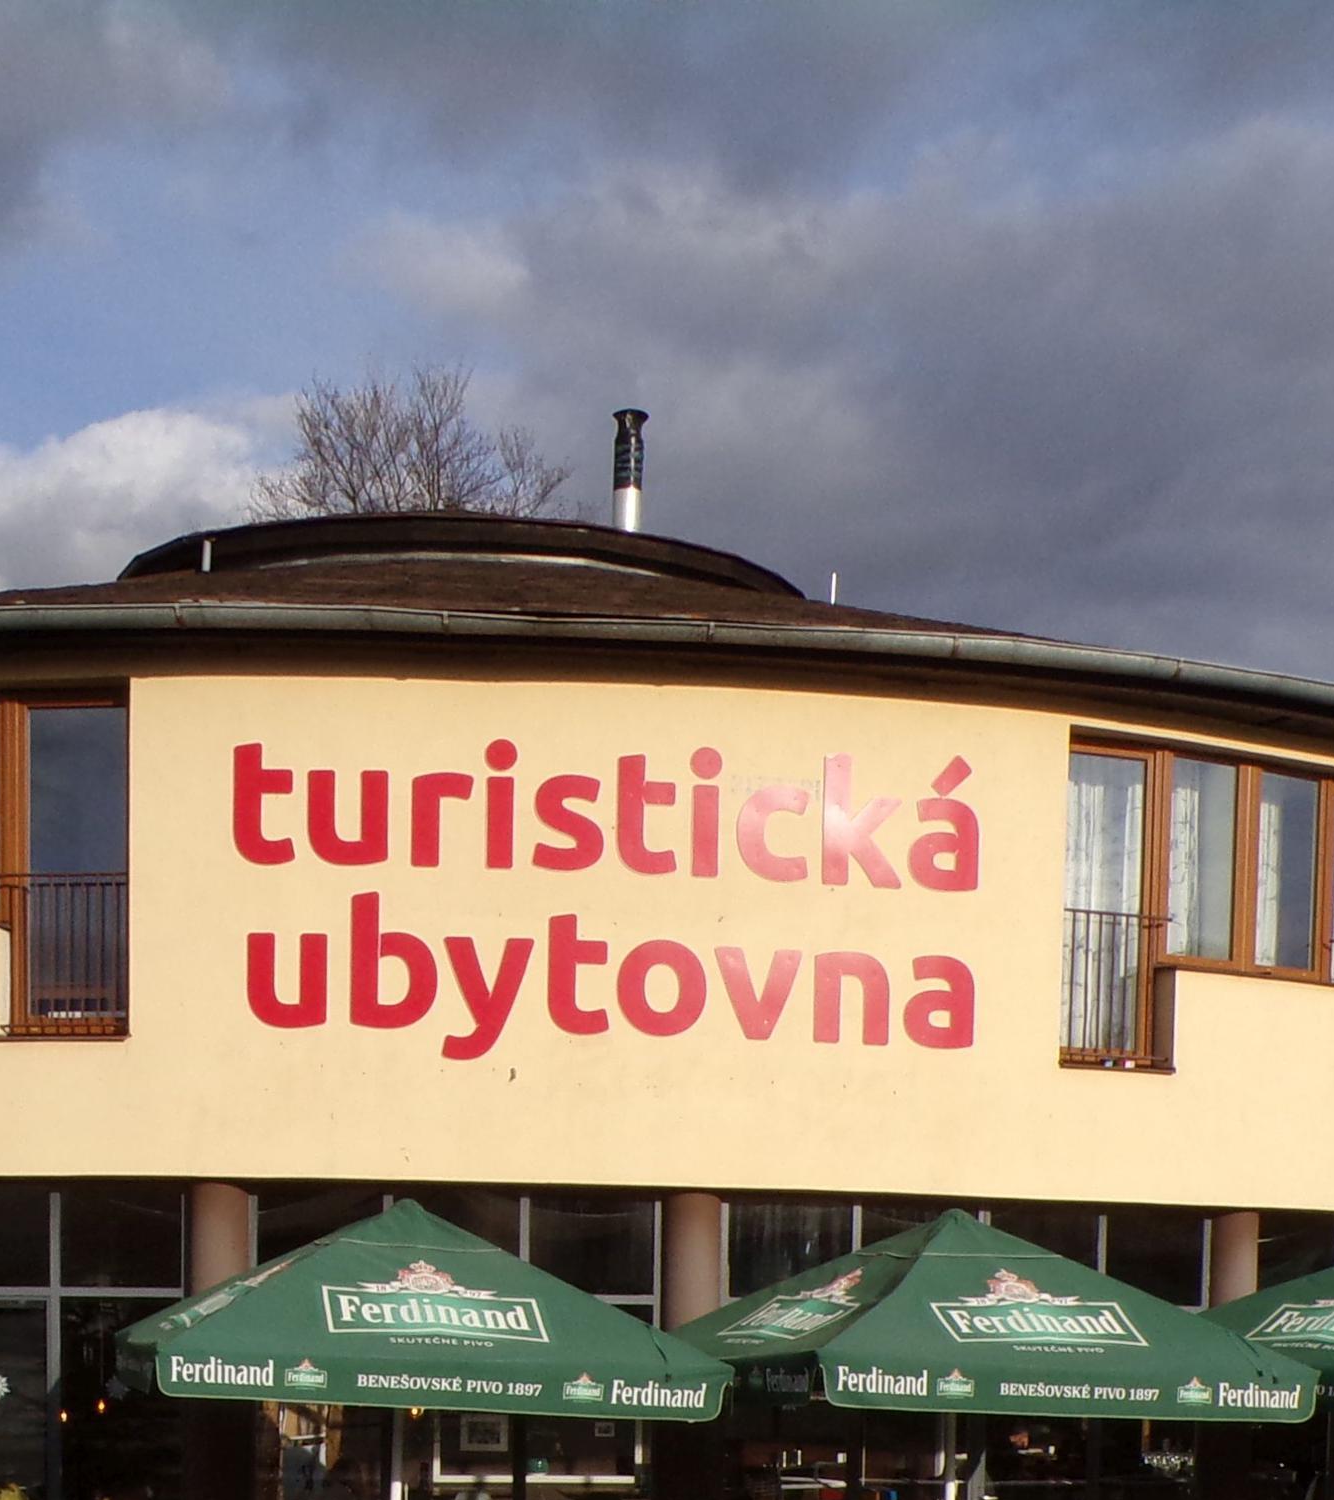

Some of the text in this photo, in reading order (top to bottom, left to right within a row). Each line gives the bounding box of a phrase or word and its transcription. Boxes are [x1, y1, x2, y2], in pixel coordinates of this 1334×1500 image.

[233, 738, 979, 892] turistická
[246, 891, 976, 1061] ubytovna
[336, 1294, 532, 1332] Ferdinand
[946, 1306, 1129, 1336] Ferdinand
[170, 1355, 275, 1387] Ferdinand
[356, 1372, 543, 1398] BENEŠOVSKÉ PIVO 1897
[836, 1364, 929, 1397] Ferdinand
[609, 1378, 708, 1409] Ferdinand
[999, 1381, 1161, 1402] BENEŠOVSKÉ PIVO 1897
[1217, 1381, 1302, 1410] Ferdinand
